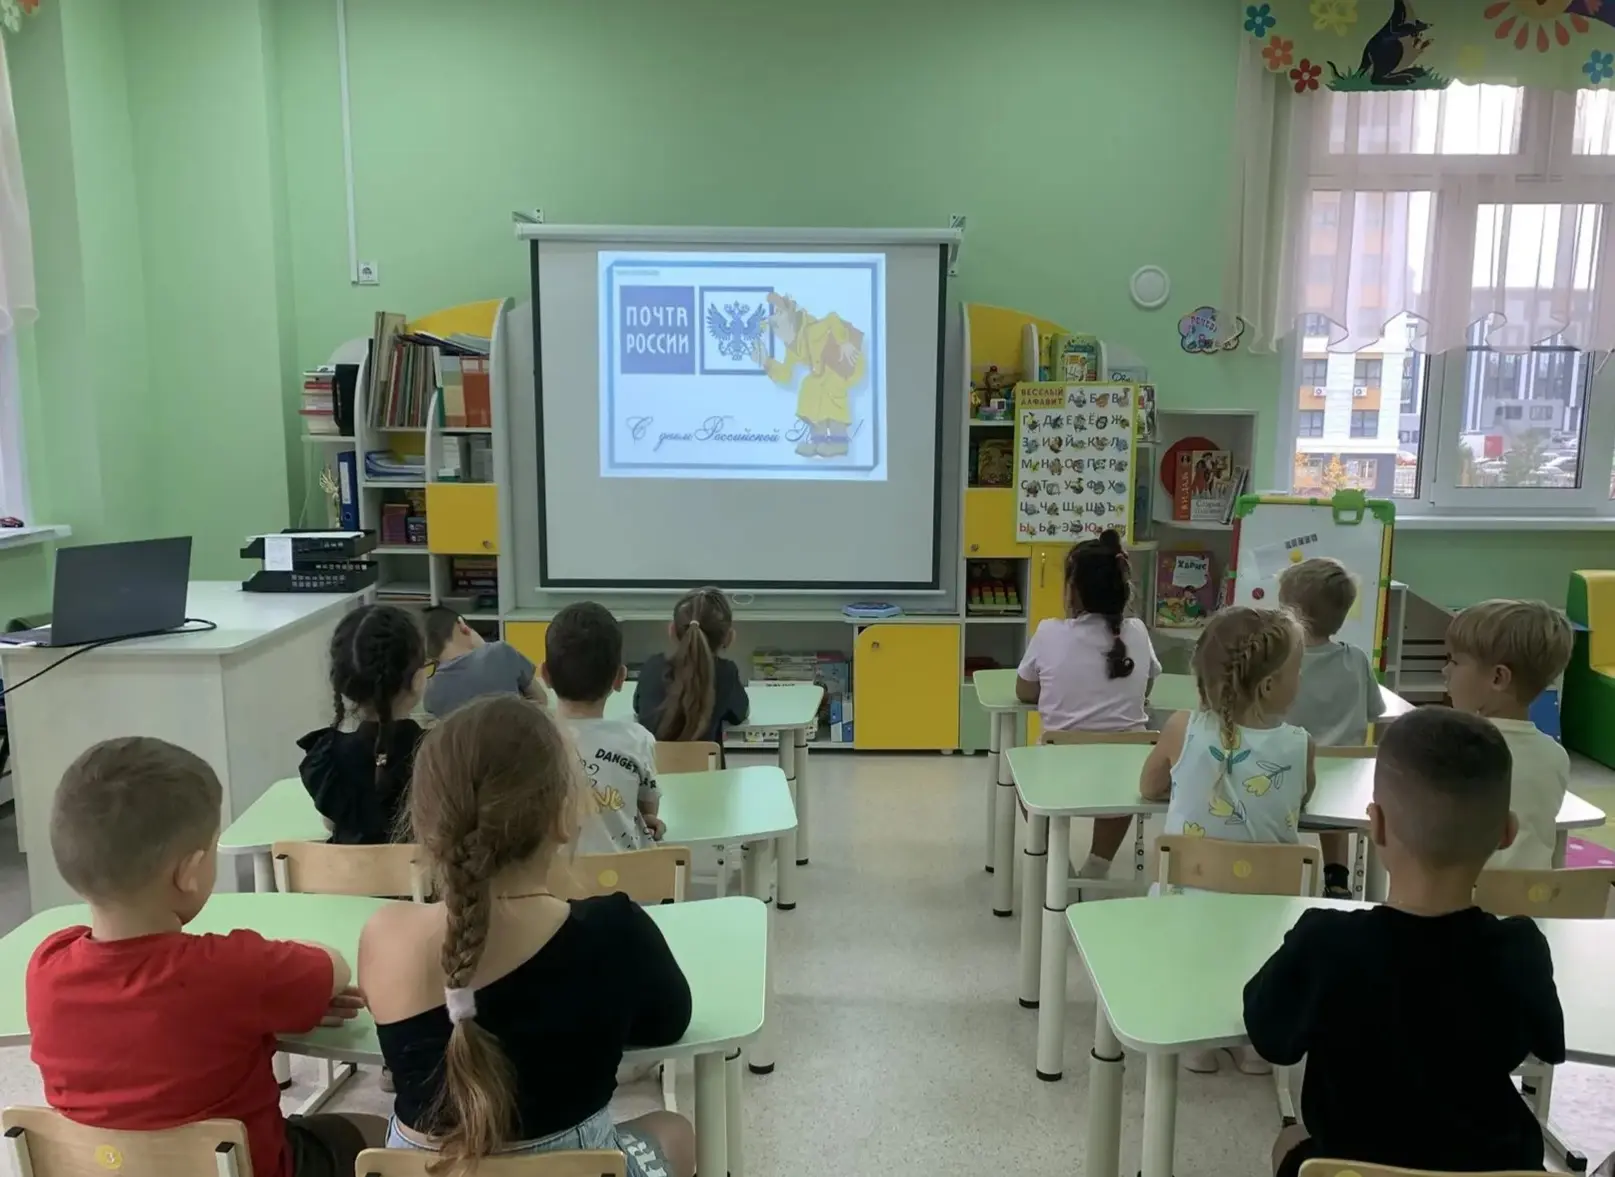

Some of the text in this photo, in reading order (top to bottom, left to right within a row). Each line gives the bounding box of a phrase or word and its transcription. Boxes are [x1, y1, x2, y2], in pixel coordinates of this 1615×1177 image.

[626, 306, 689, 327] ПОЧТА
[626, 333, 690, 354] РОССИИ
[1068, 393, 1119, 403] А Б В
[1023, 412, 1121, 426] Г Д Е Ё Ж
[626, 416, 654, 445] С
[694, 415, 780, 442] Российской
[1023, 434, 1119, 446] З И Й К Л
[1021, 459, 1116, 469] М Н О П Р
[1021, 479, 1116, 490] С Т У Ф Х
[1040, 502, 1048, 512] Ч
[1063, 502, 1074, 512] Ш
[1107, 502, 1116, 512] Ъ
[1019, 523, 1030, 532] Ы
[1039, 523, 1047, 532] Ь
[1062, 523, 1069, 532] Э
[1084, 523, 1097, 532] Ю
